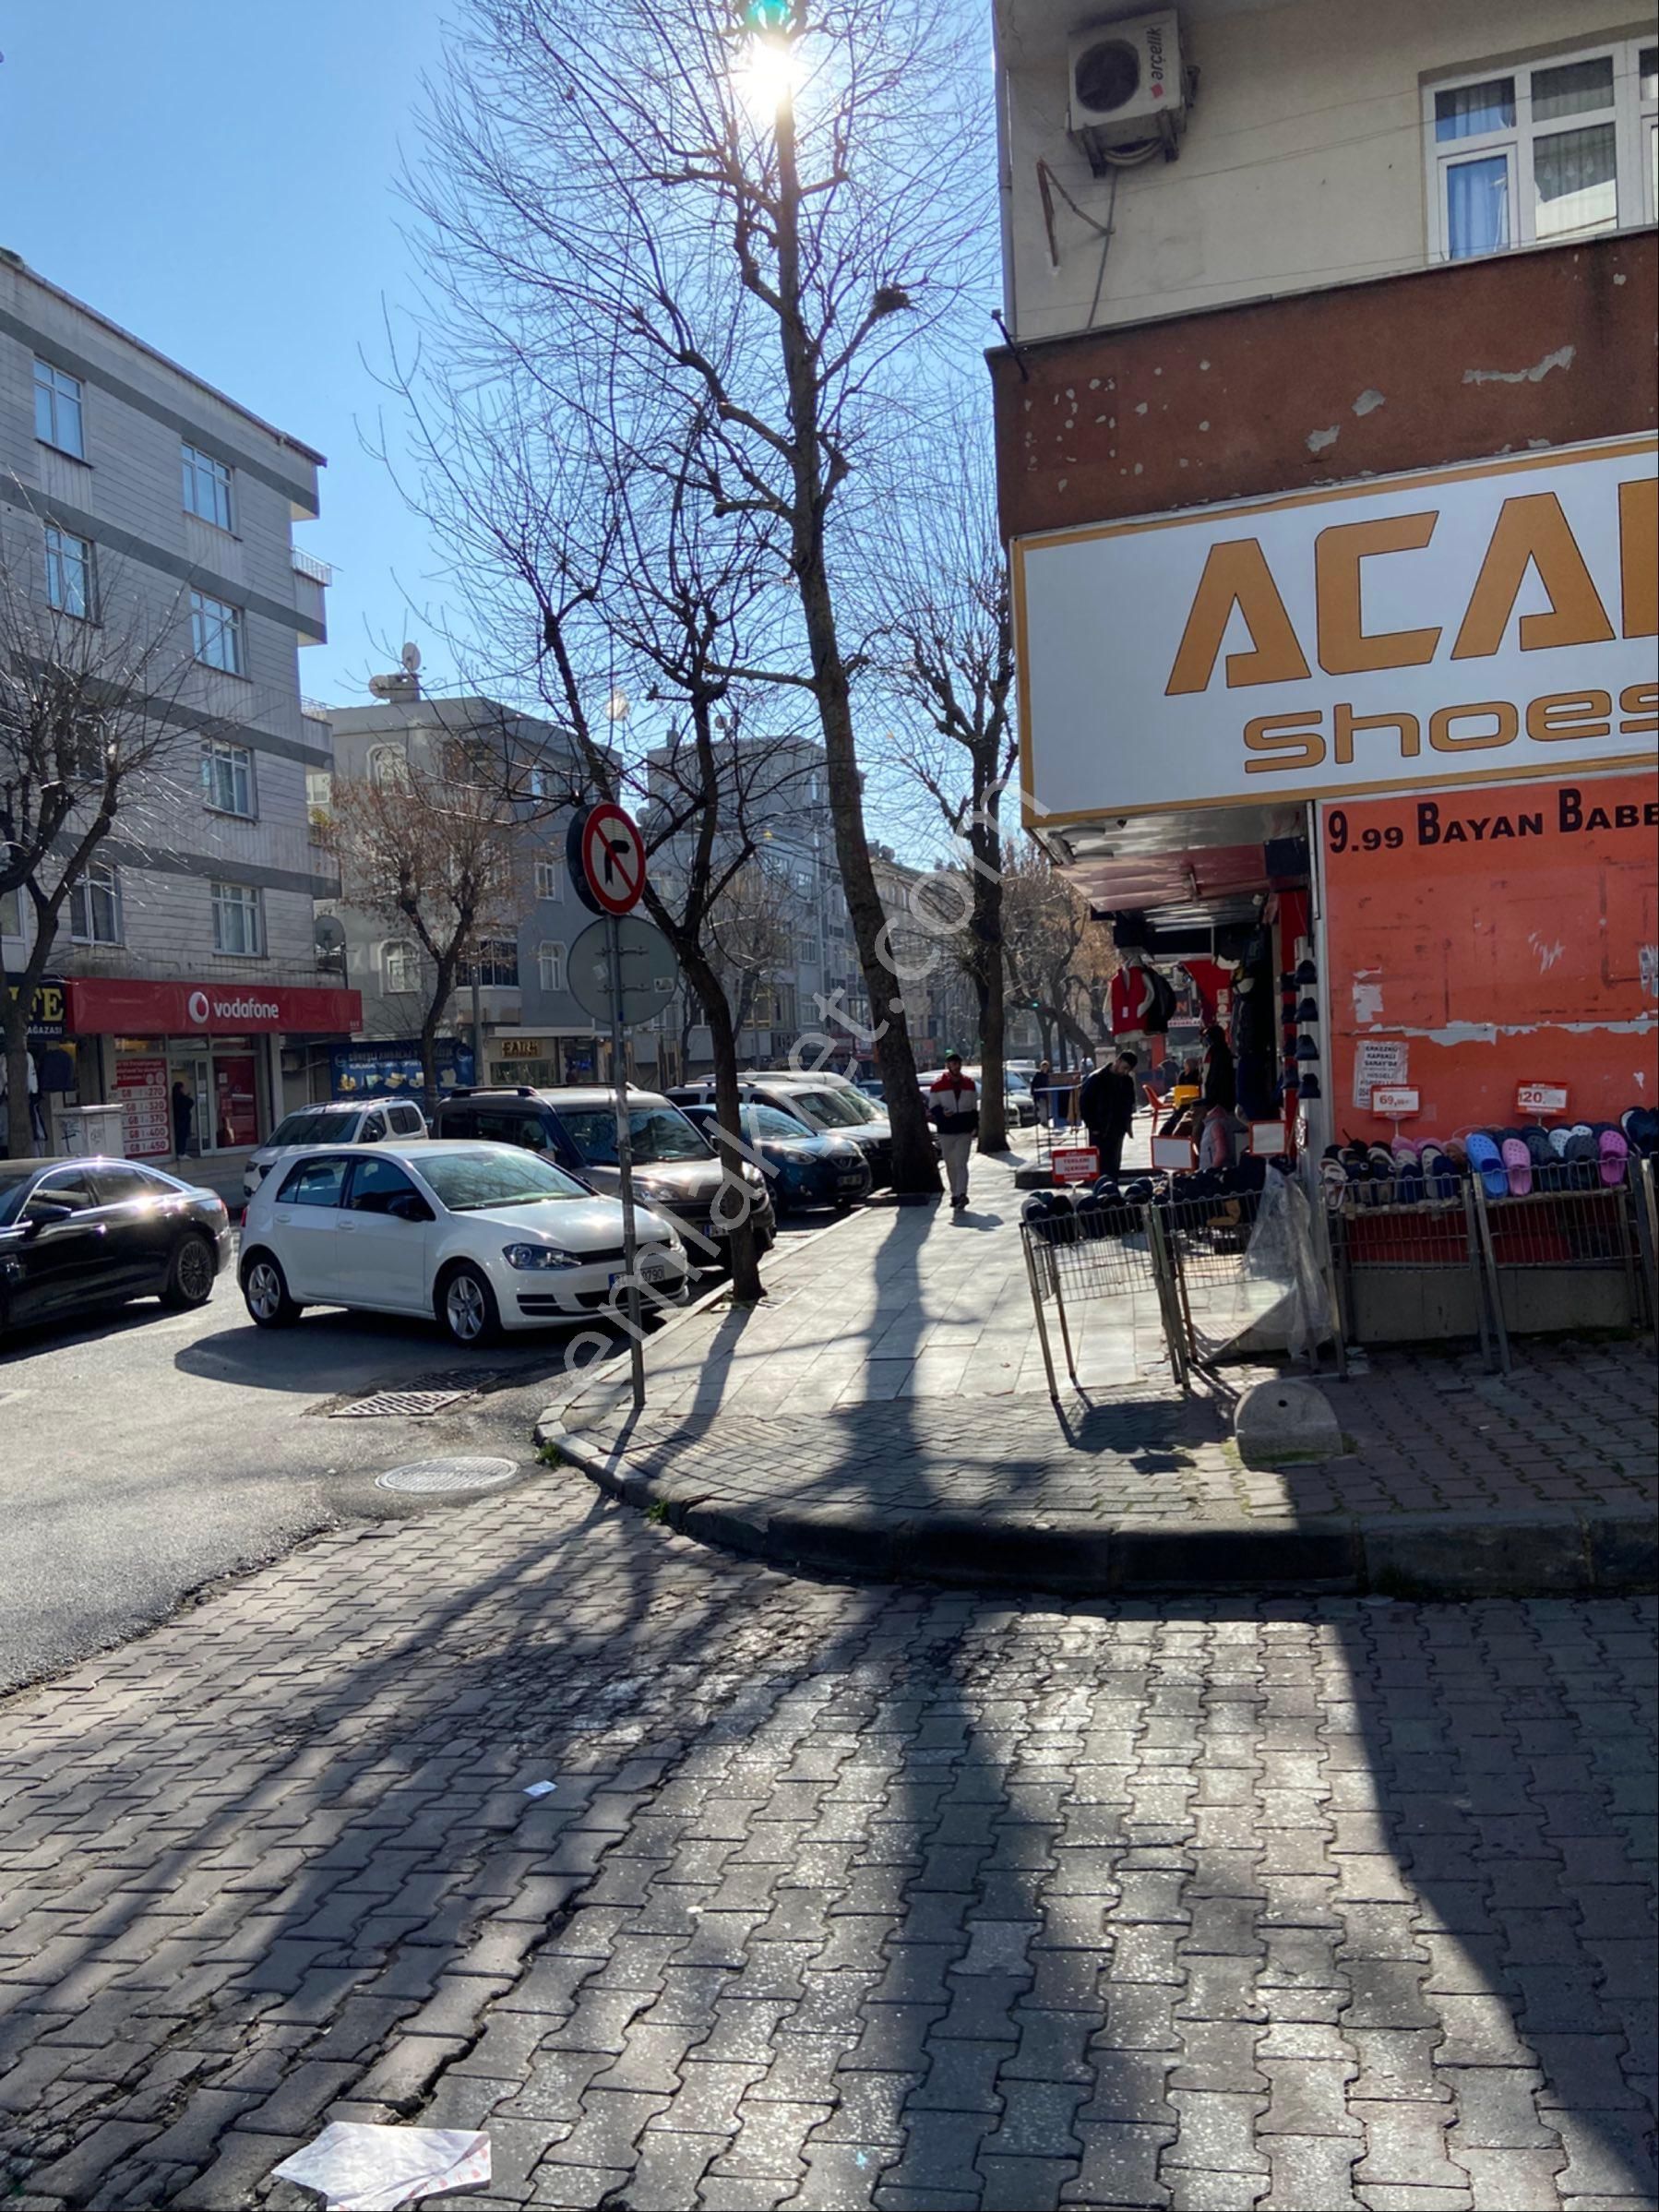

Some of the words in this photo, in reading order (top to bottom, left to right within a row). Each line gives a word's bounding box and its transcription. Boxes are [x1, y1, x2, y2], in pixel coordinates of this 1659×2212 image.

[1146, 27, 1166, 80] arçelik
[1328, 809, 1404, 854] 9.99
[213, 998, 279, 1019] vodafone
[26, 1024, 63, 1034] AĞAZASI
